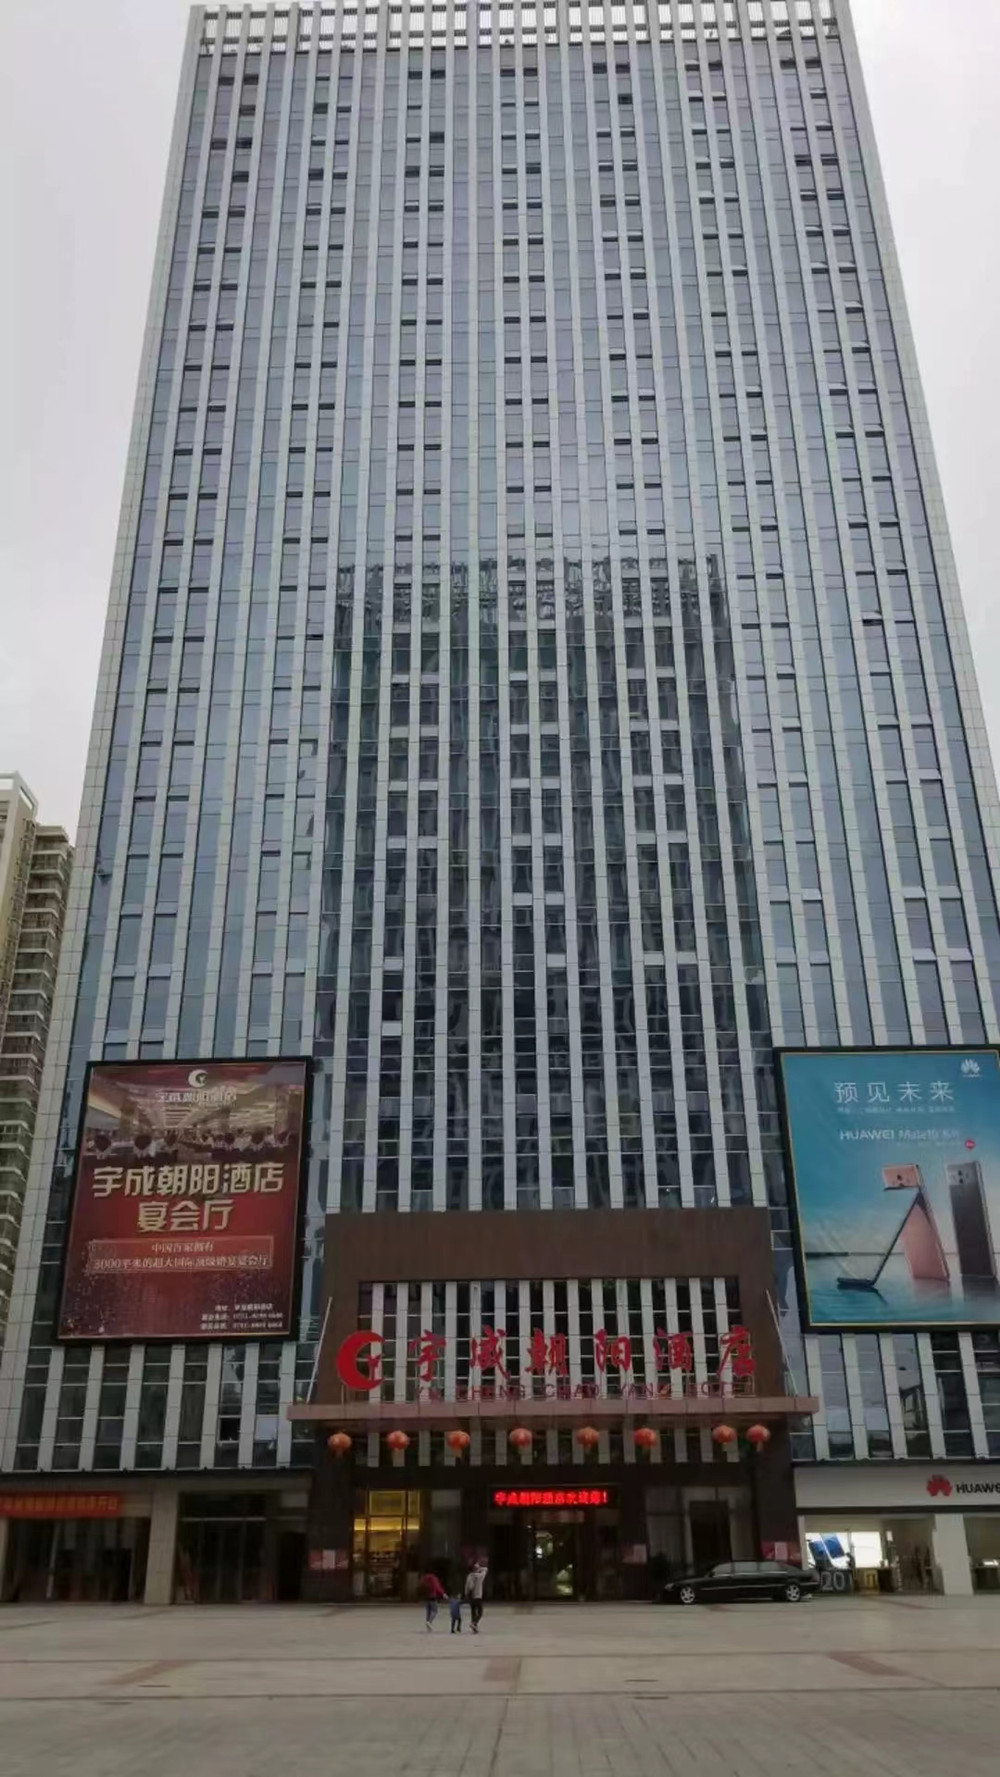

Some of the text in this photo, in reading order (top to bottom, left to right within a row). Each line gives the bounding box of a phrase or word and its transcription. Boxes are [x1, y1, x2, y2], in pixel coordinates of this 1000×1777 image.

[834, 1081, 954, 1103] 预见未来
[840, 1129, 894, 1140] HUAWEI
[92, 1162, 285, 1198] 宇成朝阳酒店
[137, 1199, 234, 1232] 宴会厅
[545, 1383, 599, 1399] CHAO
